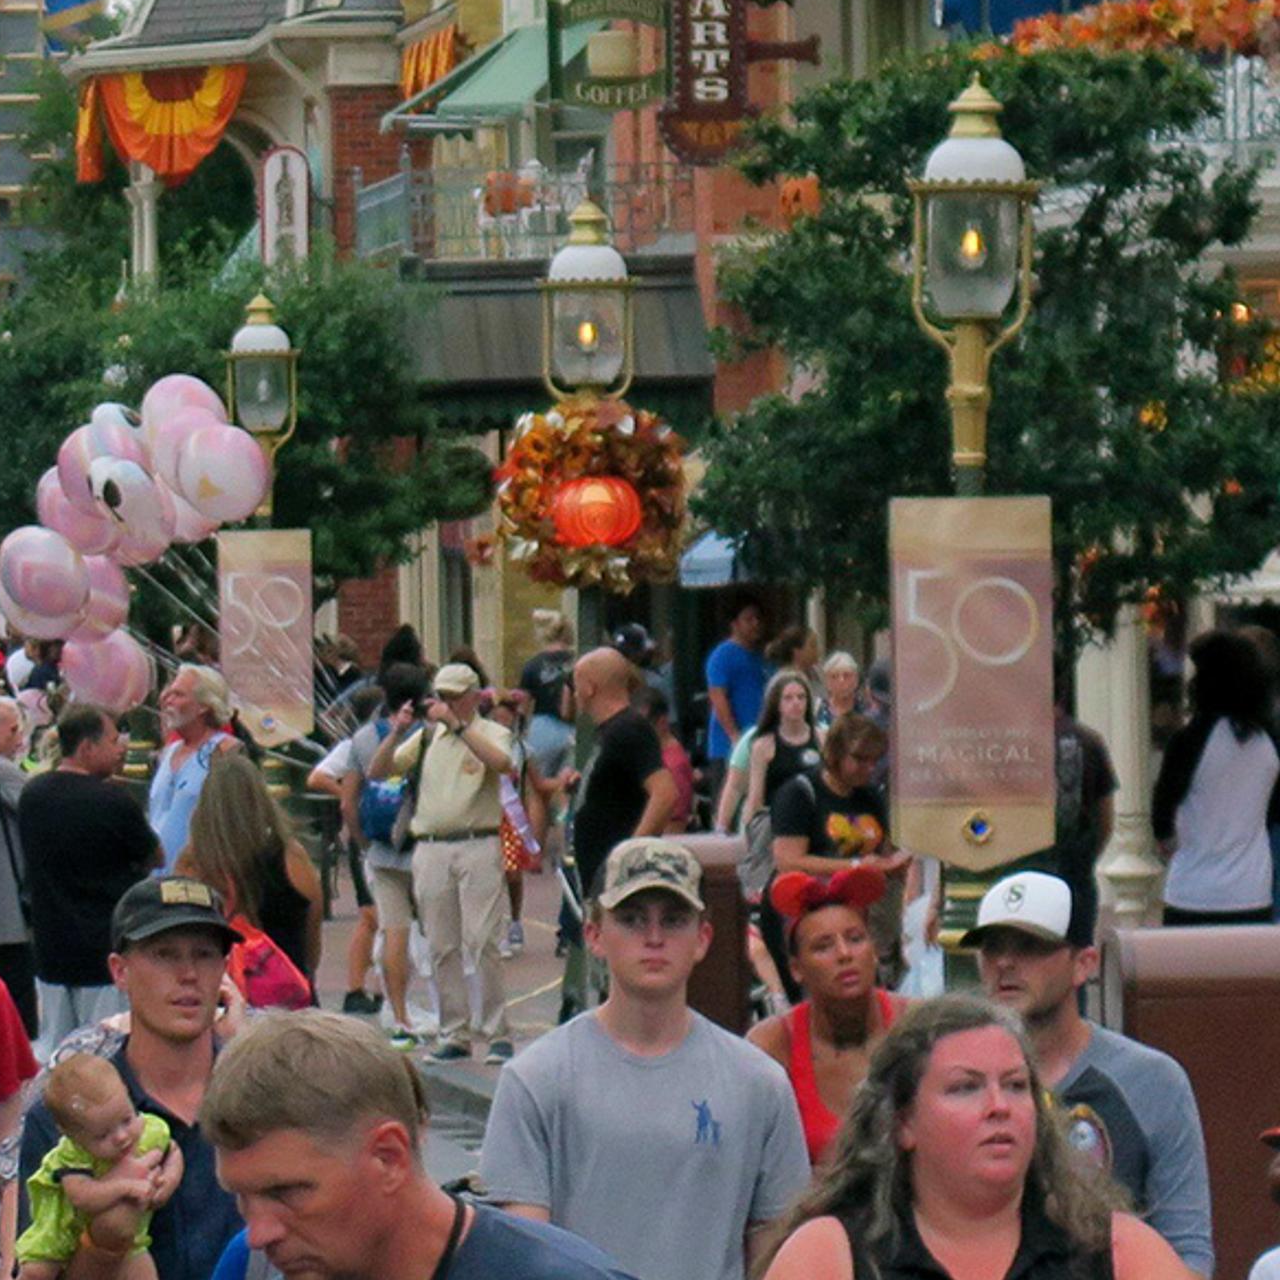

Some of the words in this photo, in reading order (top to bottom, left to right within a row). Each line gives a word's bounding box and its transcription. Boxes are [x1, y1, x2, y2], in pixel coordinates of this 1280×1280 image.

[224, 572, 305, 656] 50
[906, 569, 1039, 713] 50
[915, 743, 1036, 765] MAGICAL
